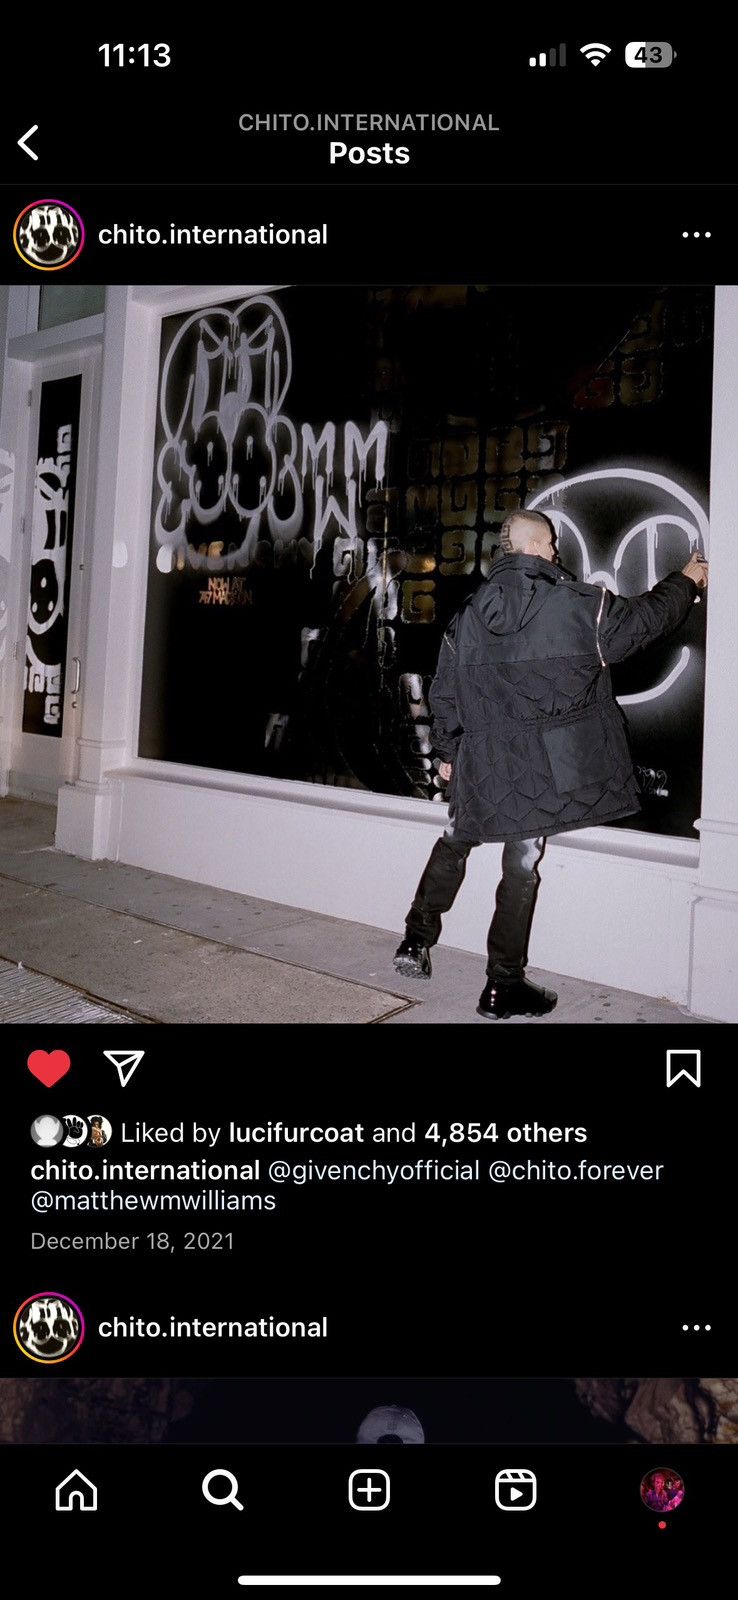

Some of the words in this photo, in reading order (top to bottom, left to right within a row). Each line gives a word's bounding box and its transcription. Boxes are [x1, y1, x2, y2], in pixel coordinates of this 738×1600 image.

[98, 42, 172, 68] 11:13
[634, 46, 663, 64] 43
[238, 113, 500, 132] CHITO.INTERNATIONAL
[329, 141, 411, 165] Posts
[98, 222, 328, 245] chito.international
[208, 576, 230, 591] NOW
[121, 1121, 184, 1143] Liked
[192, 1121, 222, 1148] by
[229, 1120, 365, 1143] lucifurcoat
[372, 1121, 416, 1143] and
[424, 1121, 499, 1148] 4,854
[506, 1121, 588, 1143] others
[30, 1158, 260, 1181] chito.international
[268, 1159, 479, 1185] @givenchyofficial
[488, 1159, 665, 1184] @chito.forever
[30, 1189, 277, 1214] @matthewmwilliams
[31, 1231, 140, 1250] December
[146, 1231, 175, 1254] 18,
[183, 1231, 235, 1250] 2021
[98, 1315, 328, 1338] chito.international
